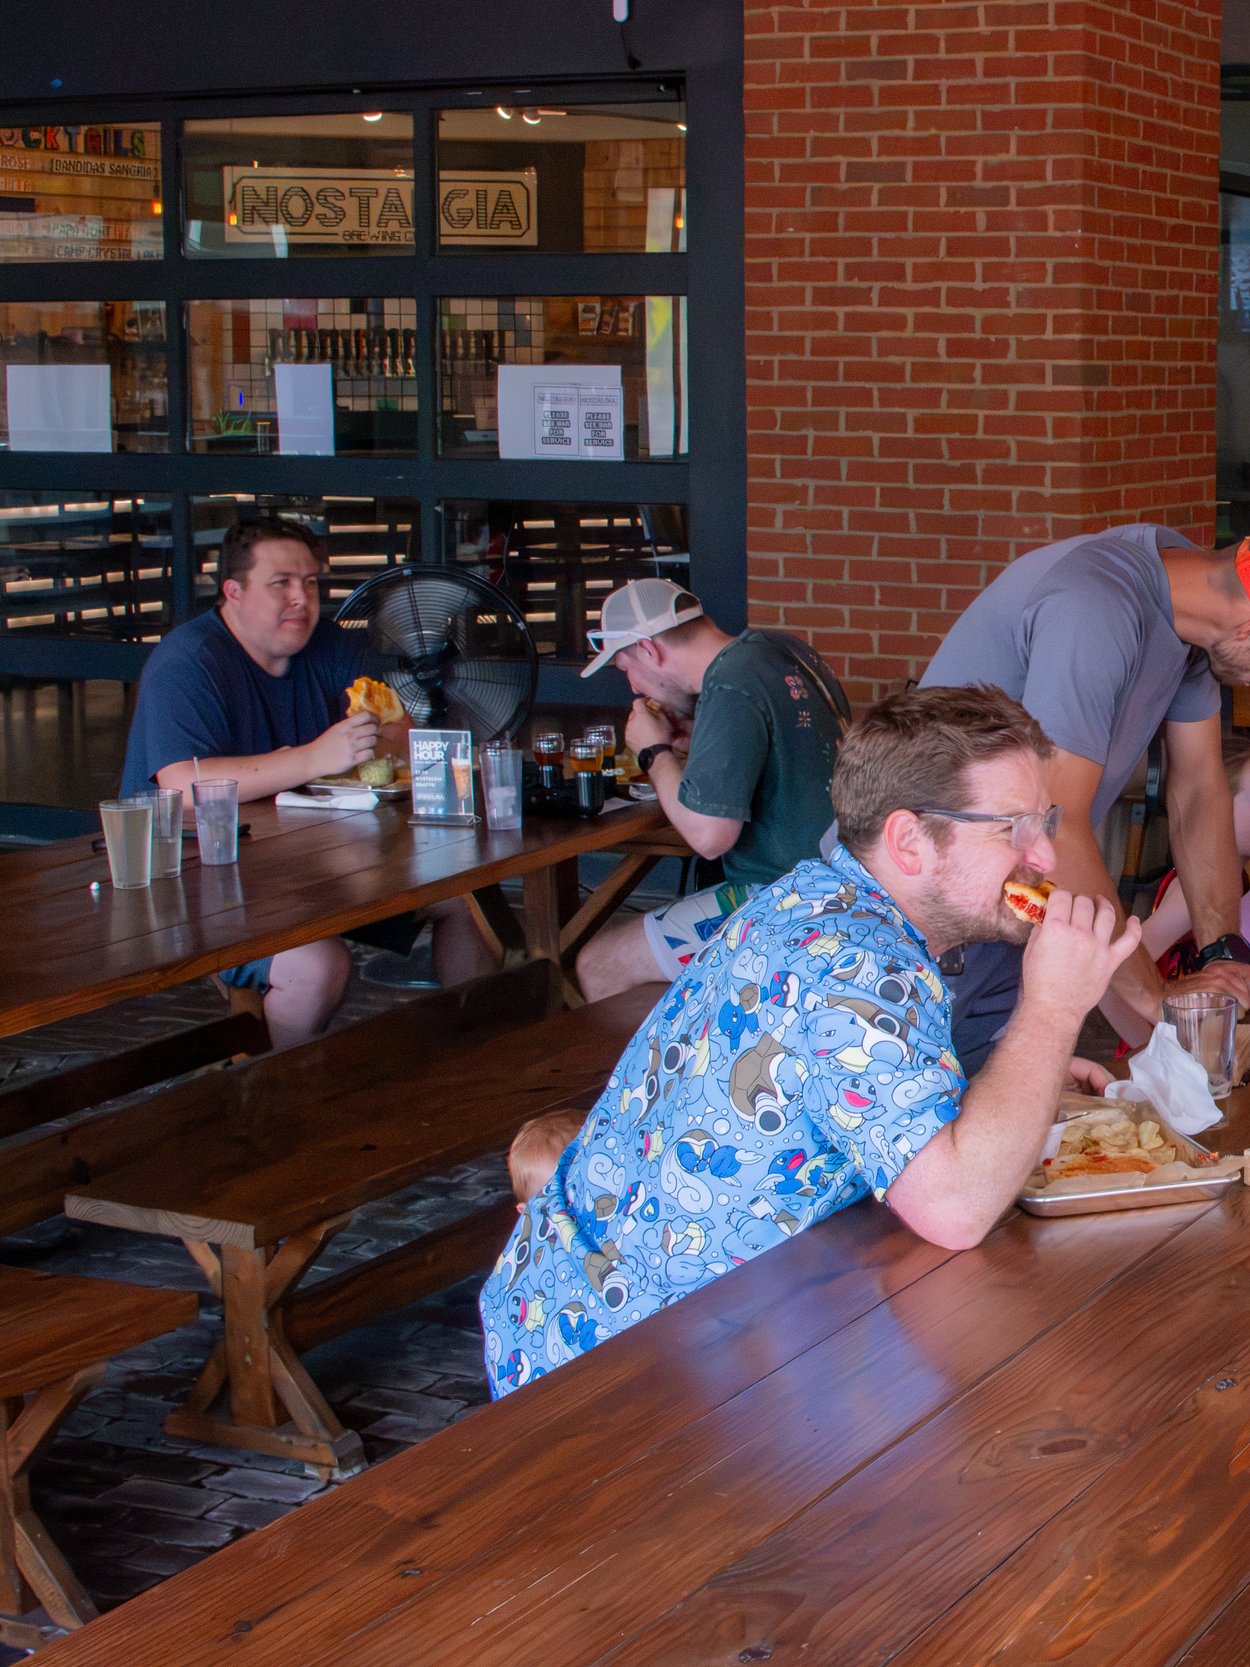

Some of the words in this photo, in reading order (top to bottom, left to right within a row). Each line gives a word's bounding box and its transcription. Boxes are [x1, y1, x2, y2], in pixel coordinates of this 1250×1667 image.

[55, 159, 105, 175] BANDIDAS
[109, 163, 151, 178] SANGRIA
[241, 185, 523, 230] NOSTAGIA
[342, 231, 401, 243] BREWING
[543, 411, 569, 419] PLEASE
[585, 412, 611, 420] PLEASE
[584, 421, 597, 429] SEE
[549, 428, 564, 436] FOR
[591, 430, 606, 438] FOR
[542, 437, 571, 445] SERVICE
[584, 439, 614, 447] SERVICE
[413, 741, 449, 751] HAPPY
[414, 750, 445, 761] HOUR
